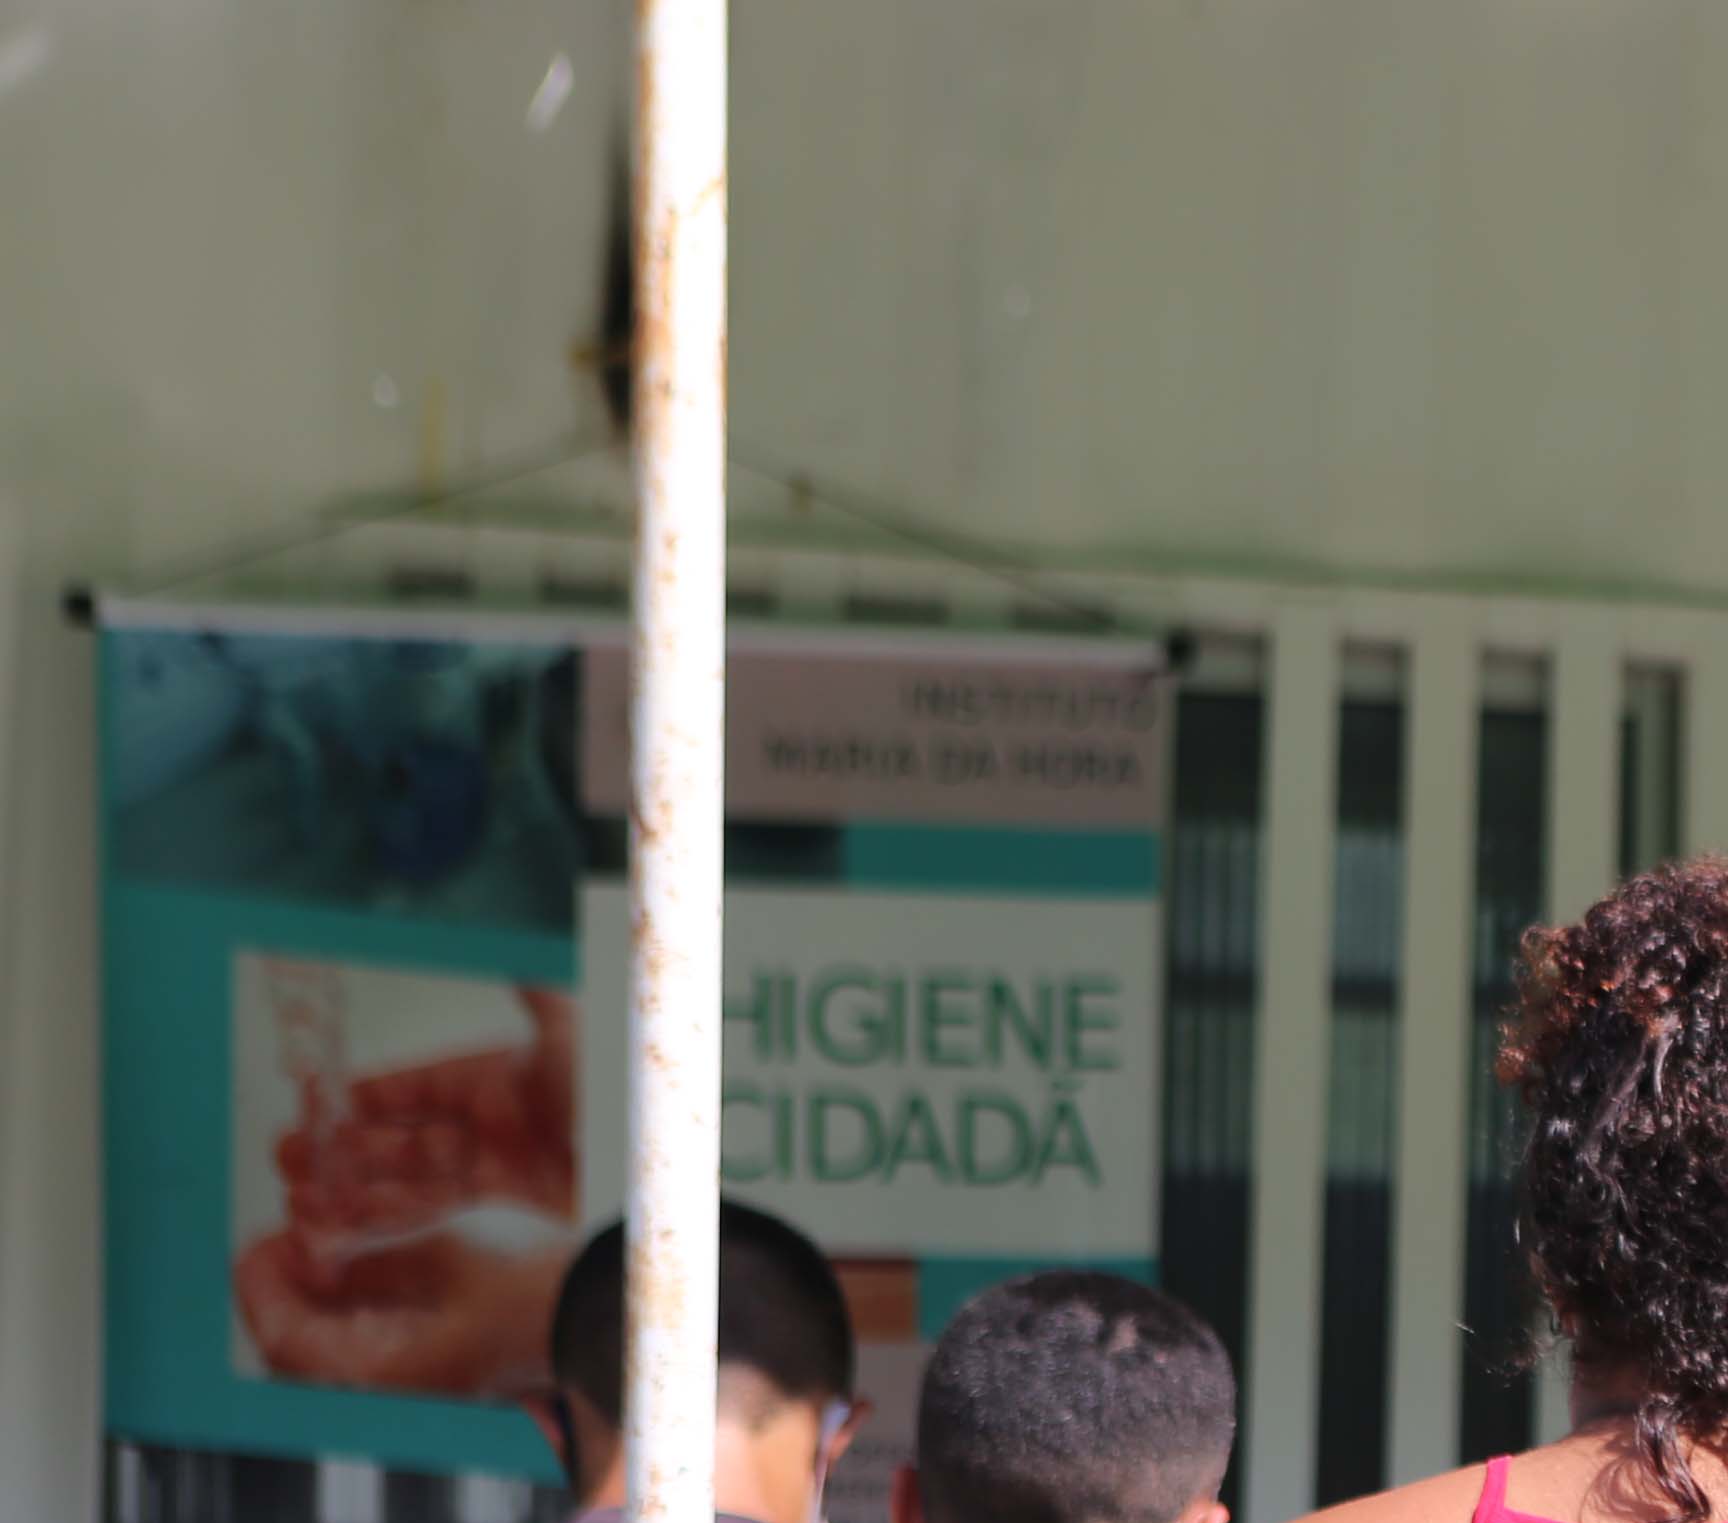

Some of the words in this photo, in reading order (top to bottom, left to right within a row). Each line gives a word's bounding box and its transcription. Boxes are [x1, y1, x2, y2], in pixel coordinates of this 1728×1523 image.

[909, 676, 1158, 730] INSTITUTO
[762, 728, 919, 778] MARIA
[929, 731, 998, 784] DA
[1008, 737, 1142, 787] HORA
[723, 964, 1122, 1071] HIGIENE
